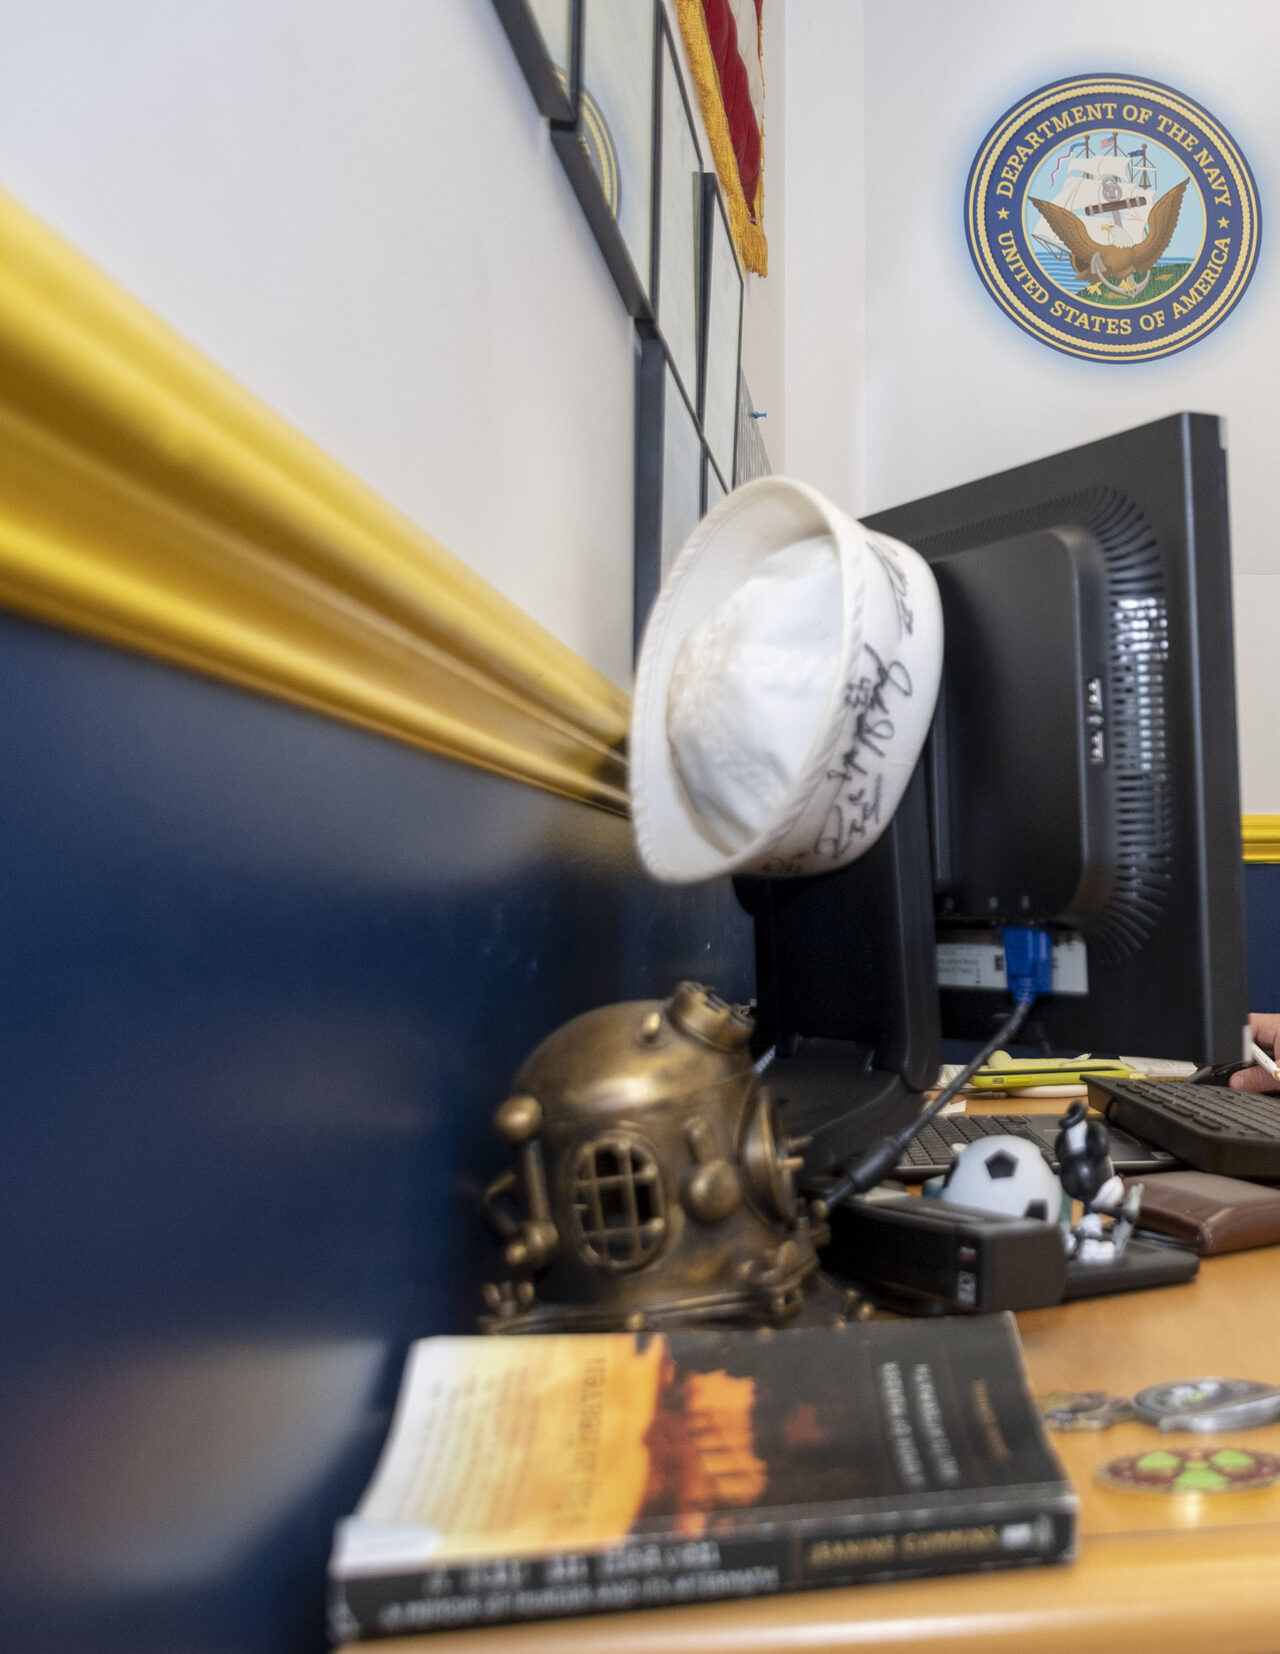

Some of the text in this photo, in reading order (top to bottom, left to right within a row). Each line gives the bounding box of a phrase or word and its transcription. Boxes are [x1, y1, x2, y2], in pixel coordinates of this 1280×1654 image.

[996, 102, 1232, 207] DEPARTMENT OF THE NAVY
[997, 230, 1232, 335] UNITED STATES OF AMERICA
